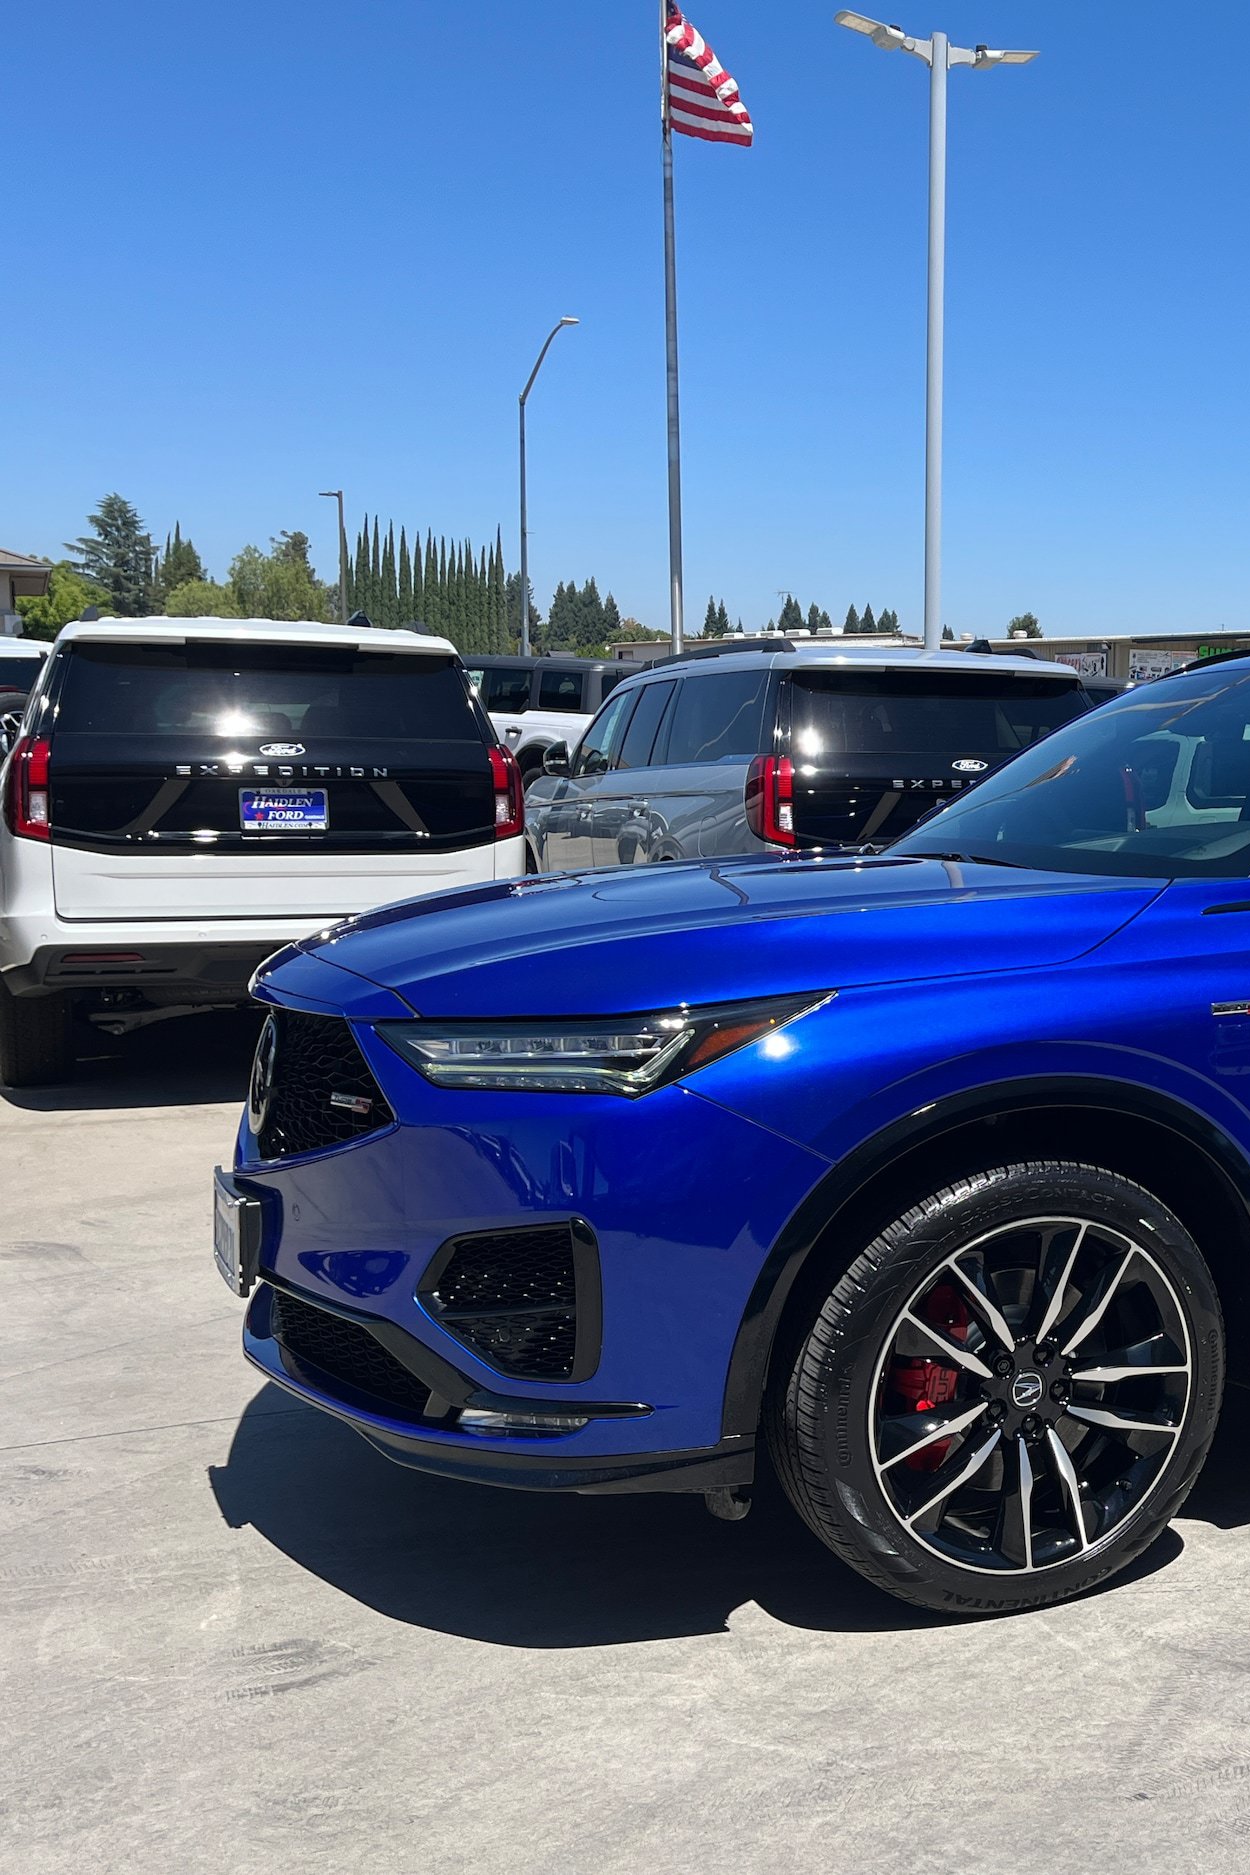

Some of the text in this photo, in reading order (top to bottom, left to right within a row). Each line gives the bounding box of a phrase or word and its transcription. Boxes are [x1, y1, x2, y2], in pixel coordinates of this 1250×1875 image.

[175, 765, 388, 778] EXPEDITION
[251, 796, 314, 809] HAIDLEN
[267, 810, 304, 820] FORD
